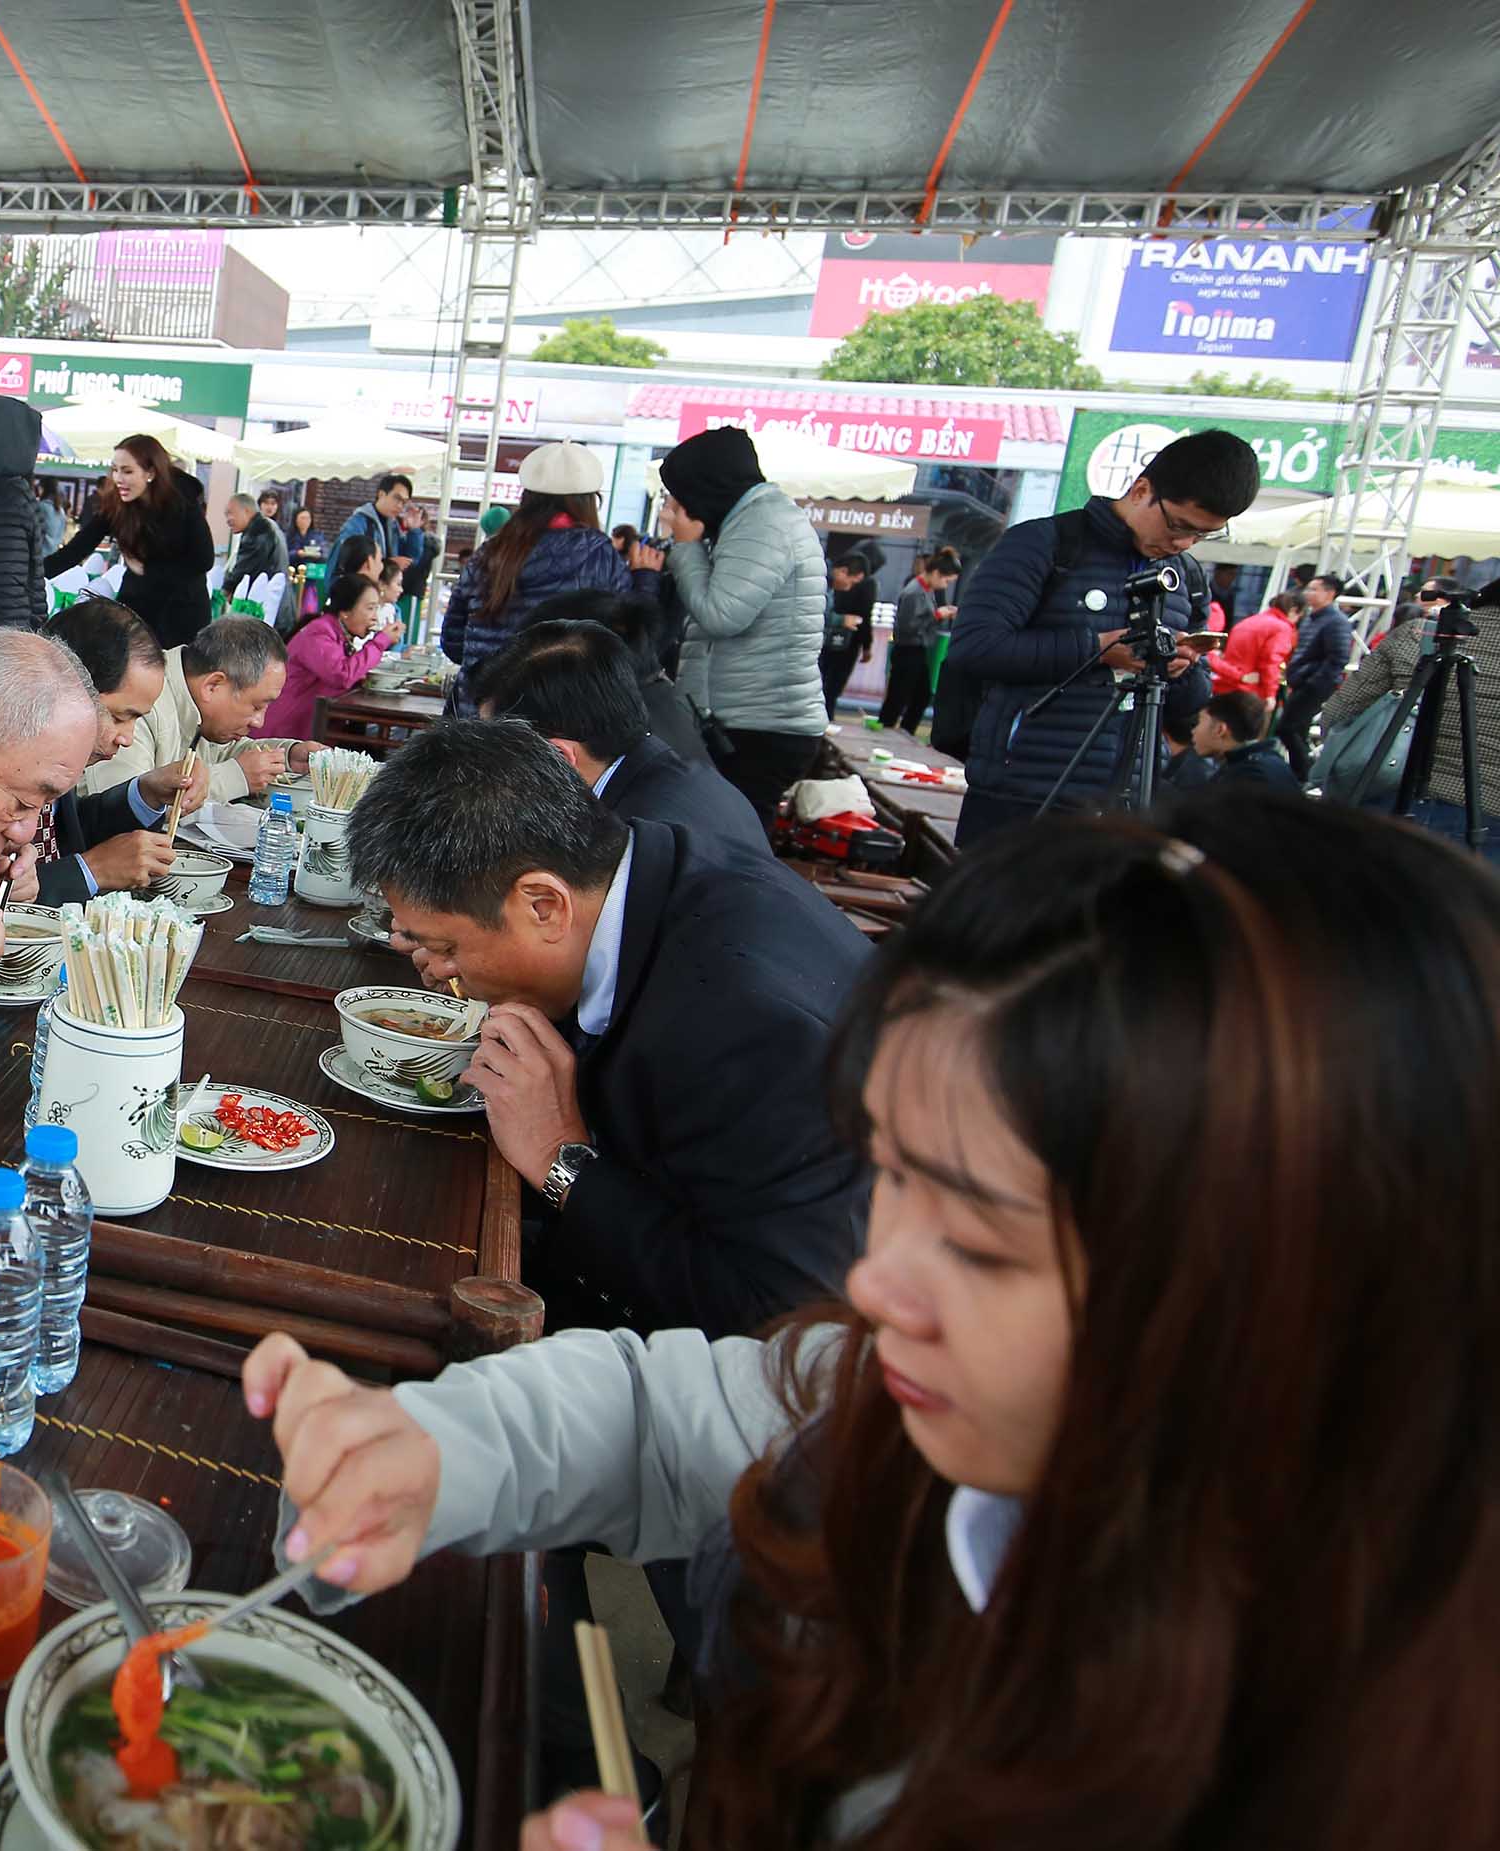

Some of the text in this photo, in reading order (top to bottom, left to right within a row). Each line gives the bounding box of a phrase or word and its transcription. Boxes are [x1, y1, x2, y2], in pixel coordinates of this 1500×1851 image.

[33, 361, 71, 395] PHỞ
[837, 419, 913, 454] HƯNG
[919, 417, 975, 458] BỀN
[1251, 427, 1327, 483] HỞ
